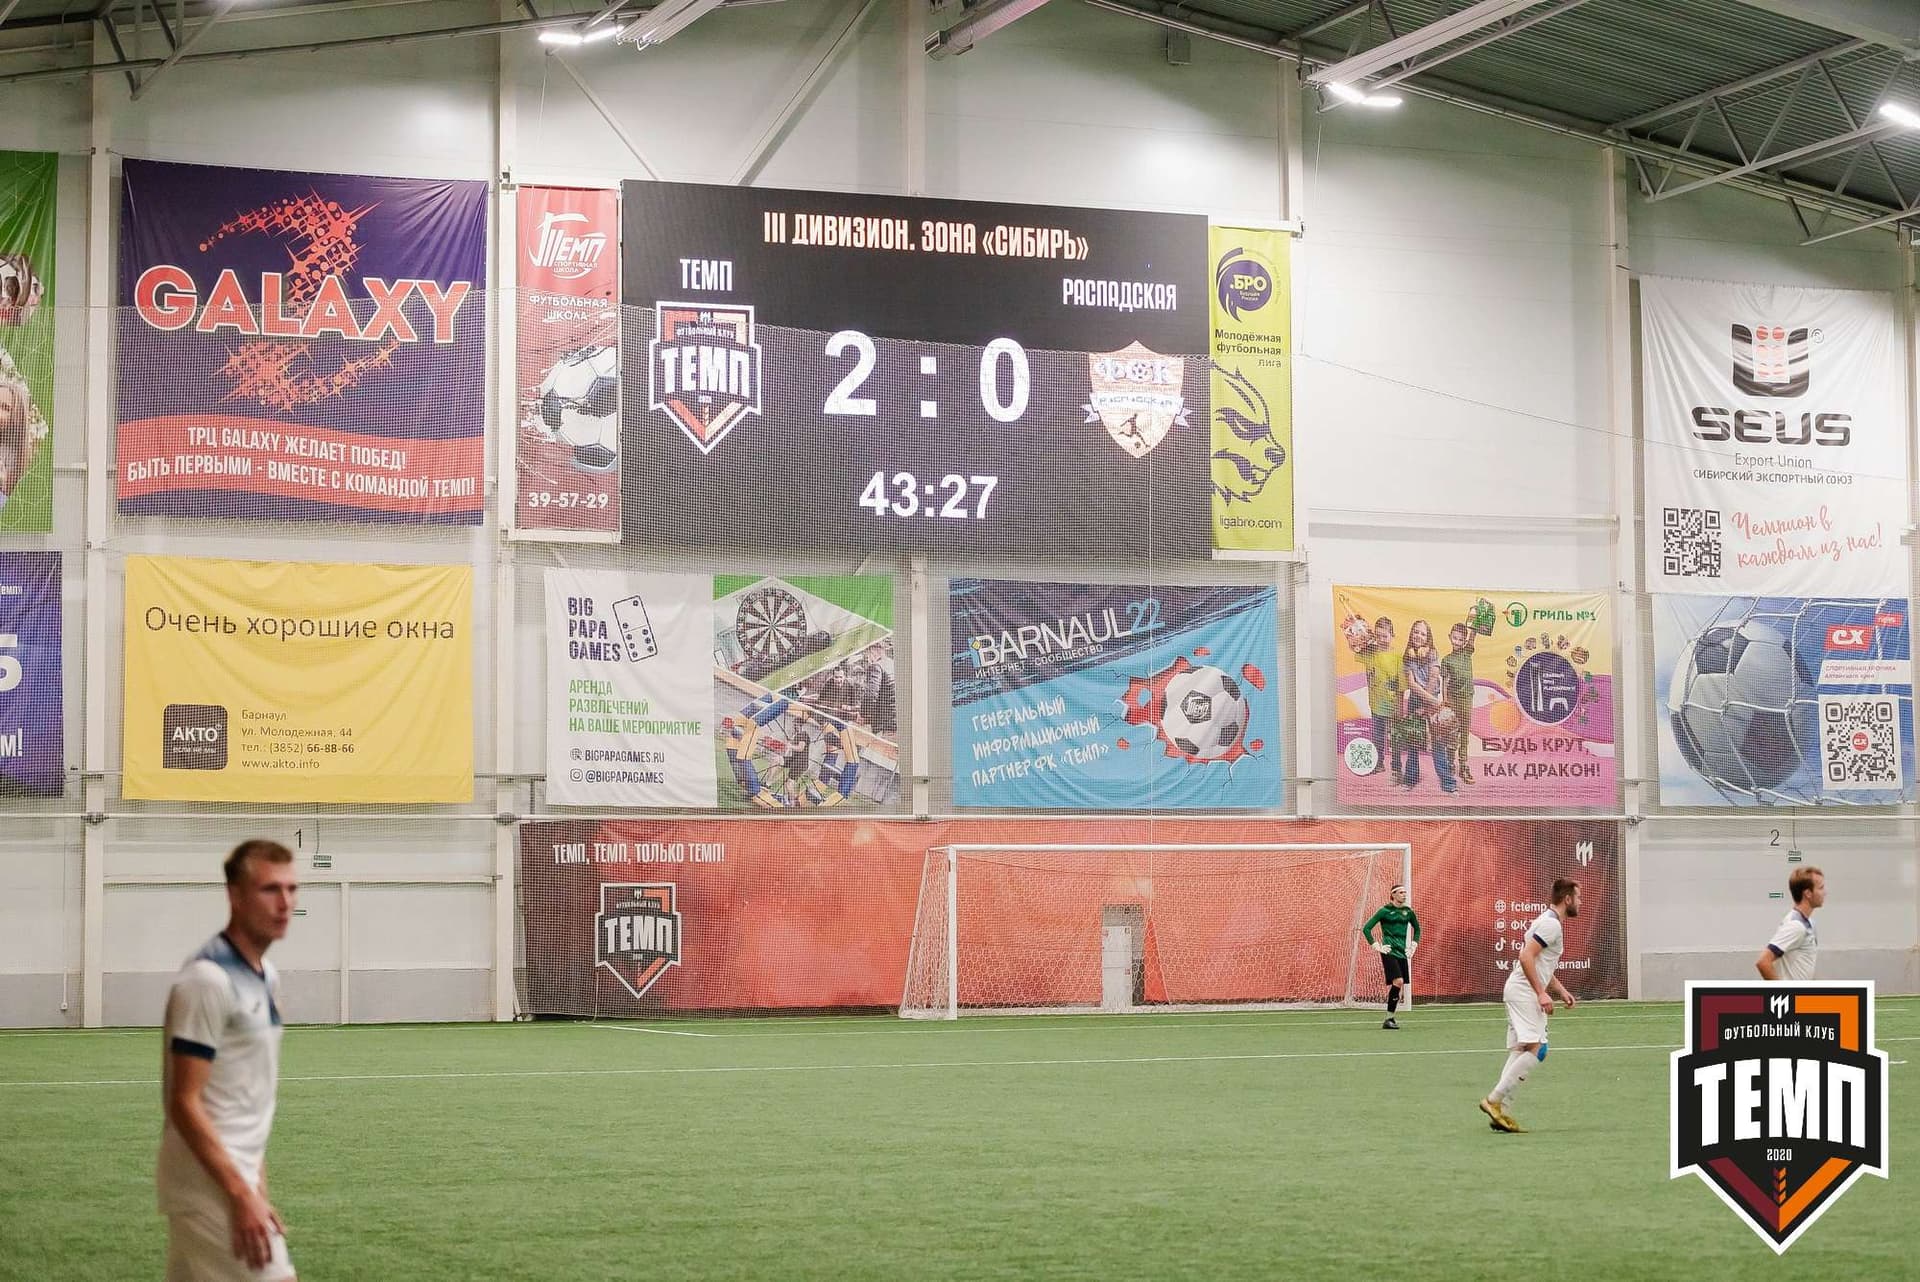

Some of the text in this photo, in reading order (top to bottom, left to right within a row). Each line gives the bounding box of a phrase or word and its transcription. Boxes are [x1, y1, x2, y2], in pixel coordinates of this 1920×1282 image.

[792, 214, 915, 251] ДИВИЗИОН.
[922, 221, 976, 254] ЗОНА
[982, 225, 1089, 260] «СИБИРЬ»
[679, 258, 733, 291] ТЕМП
[134, 265, 471, 343] GALAXY
[529, 295, 608, 307] ФУТБОЛЬНАЯ
[1063, 279, 1176, 312] РАСПАДСКАЯ
[547, 310, 588, 320] ШКОЛА
[1215, 329, 1281, 343] Молодёжная
[1217, 342, 1281, 355] футбольная
[661, 346, 749, 398] ТЕМП
[1258, 359, 1281, 367] лига
[823, 330, 877, 415] 2
[979, 337, 1030, 421] 0
[1692, 407, 1852, 446] SEUS
[188, 427, 406, 470] ТРЦ GALAXY ЖЕЛАЕТ ПОБЕД!
[1735, 453, 1812, 469] Export Union
[127, 456, 170, 482] БЫТЬ
[175, 456, 251, 476] ПЕРВЫМИ
[268, 461, 325, 487] ВМЕСТЕ
[331, 470, 340, 488] С
[346, 470, 429, 499] КОМАНДОЙ
[433, 477, 475, 497] ТЕМП!
[1693, 469, 1852, 484] СИБИРСКИЙ ЭКСПОРТНЫЙ СОЮЗ
[528, 492, 609, 508] 39-57-29
[859, 472, 998, 518] 43:27
[1220, 515, 1282, 529] ligabro.com
[1732, 512, 1817, 539] Чемпион
[1738, 522, 1882, 567] каждом из нас!
[0, 584, 22, 595] емп»
[568, 597, 593, 617] BIG
[1533, 609, 1573, 620] ГРИЛЬ
[146, 607, 454, 641] Очень хорошие окна
[568, 620, 608, 640] PAPA
[569, 640, 621, 662] GAMES
[569, 679, 613, 696] АРЕНДА
[241, 709, 287, 721] Барнаул
[569, 698, 649, 715] РАЗВЛЕЧЕНИЙ
[972, 695, 1066, 731] ГЕНЕРАЛЬНЫЙ
[172, 726, 218, 742] АКТО
[241, 728, 256, 738] ул.
[340, 728, 352, 737] 44
[569, 718, 701, 735] НА ВАШЕ МЕРОПРИЯТИЕ
[0, 728, 23, 756] М!
[972, 714, 1100, 760] ИНФОРМАЦИОННЫЙ
[269, 743, 304, 754] (3852)
[307, 744, 354, 753] 66-88-66
[1482, 738, 1589, 755] БУДЬ КРУТ,
[241, 758, 320, 769] www.akto.info
[585, 749, 665, 764] BIGPAPAGAMES.RU
[972, 743, 1110, 788] ПАРТНЕР ФК «ТЕМП»
[585, 769, 664, 785] @BIGPAPAGAMES
[1484, 763, 1600, 780] КАК ДРАКОН!
[295, 828, 301, 848] 1
[1770, 829, 1780, 847] 2
[553, 843, 725, 865] ТЕМП, ТЕМП, ТОЛЬКО ТЕМП!
[605, 916, 672, 953] ТЕМП
